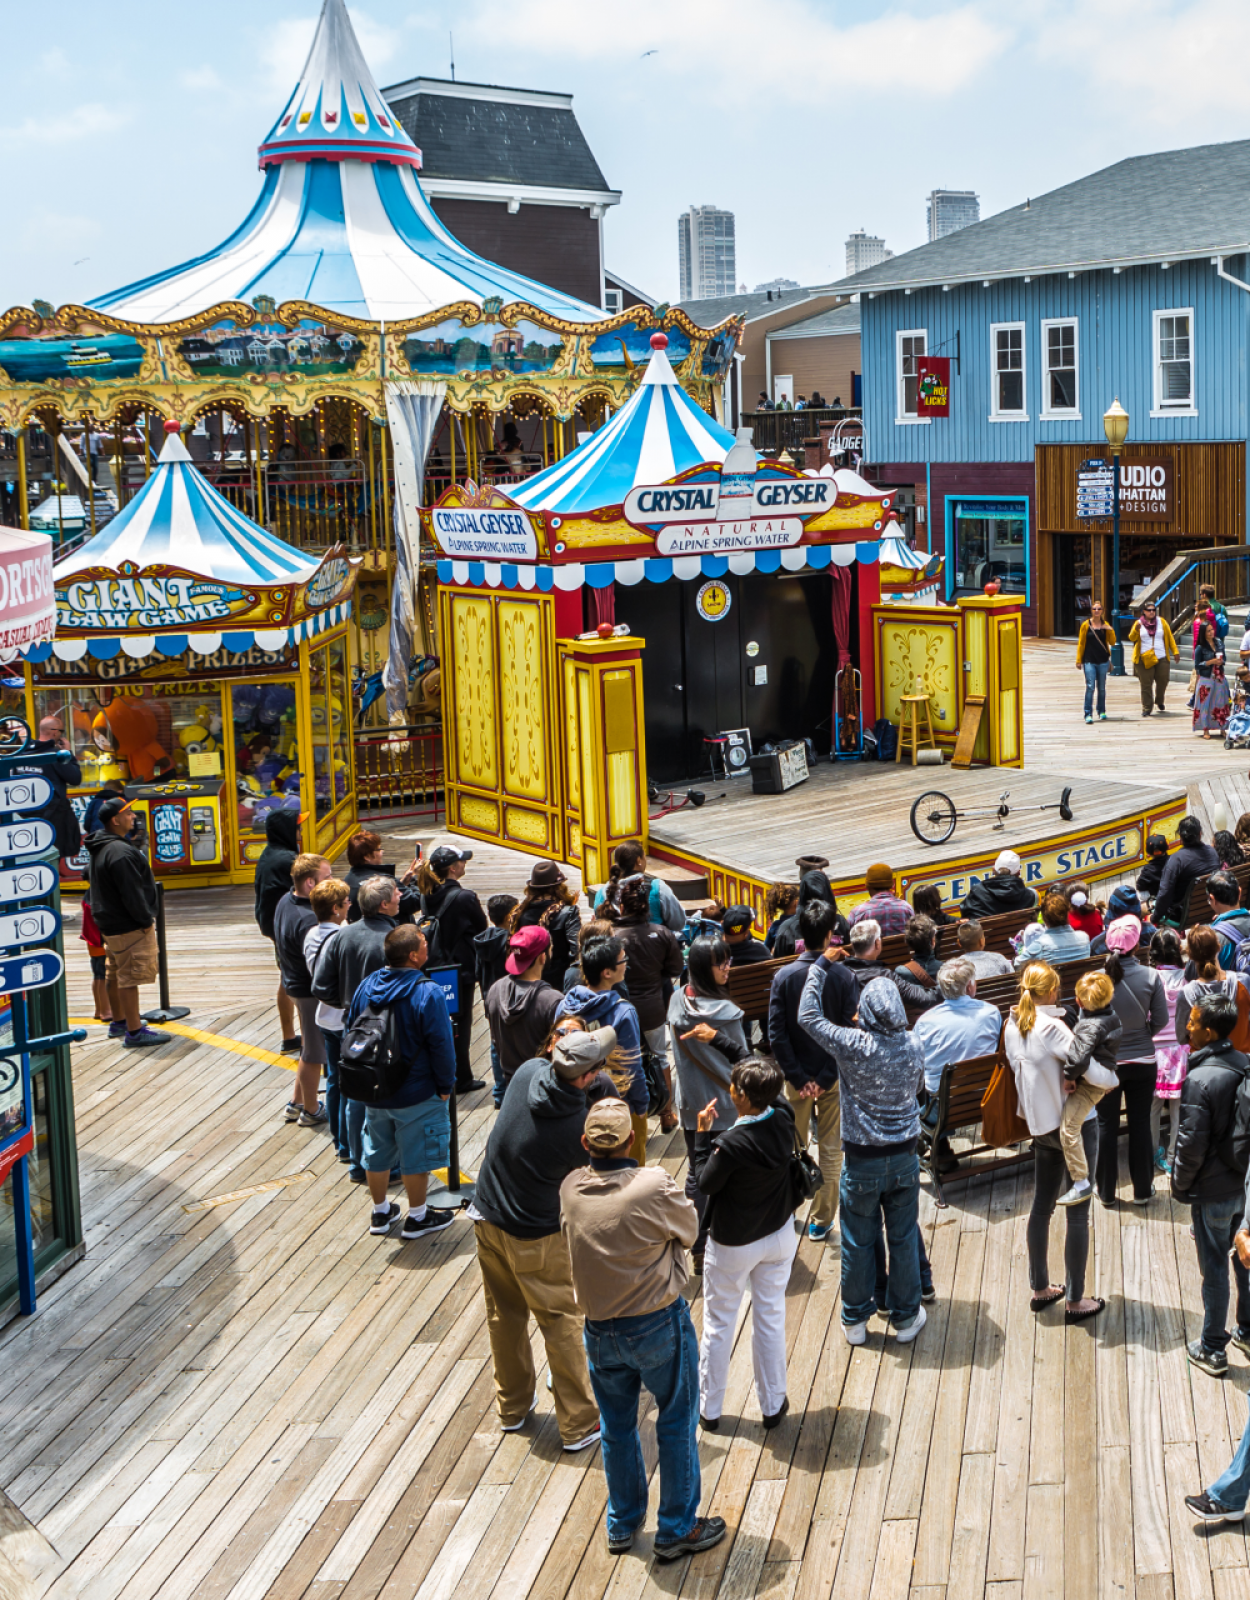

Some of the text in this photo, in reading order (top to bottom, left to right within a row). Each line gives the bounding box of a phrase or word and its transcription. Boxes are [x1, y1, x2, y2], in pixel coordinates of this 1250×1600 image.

[925, 396, 947, 406] LICKS
[933, 387, 948, 396] HOT
[637, 483, 828, 512] CRYSTAL GEYSER
[437, 511, 527, 535] CRYSTAL GEYSER
[684, 520, 787, 538] NATURAL
[448, 536, 528, 555] ALPINE SPRING WATER
[669, 532, 790, 552] ALPINE SPRING WATER
[67, 577, 225, 612] GIANT FAMOUS
[55, 600, 230, 628] LAW GAME
[44, 654, 90, 676] WIN
[186, 646, 286, 672] PRIZES!
[152, 680, 221, 696] PRIZES
[1056, 836, 1128, 875] STAGE
